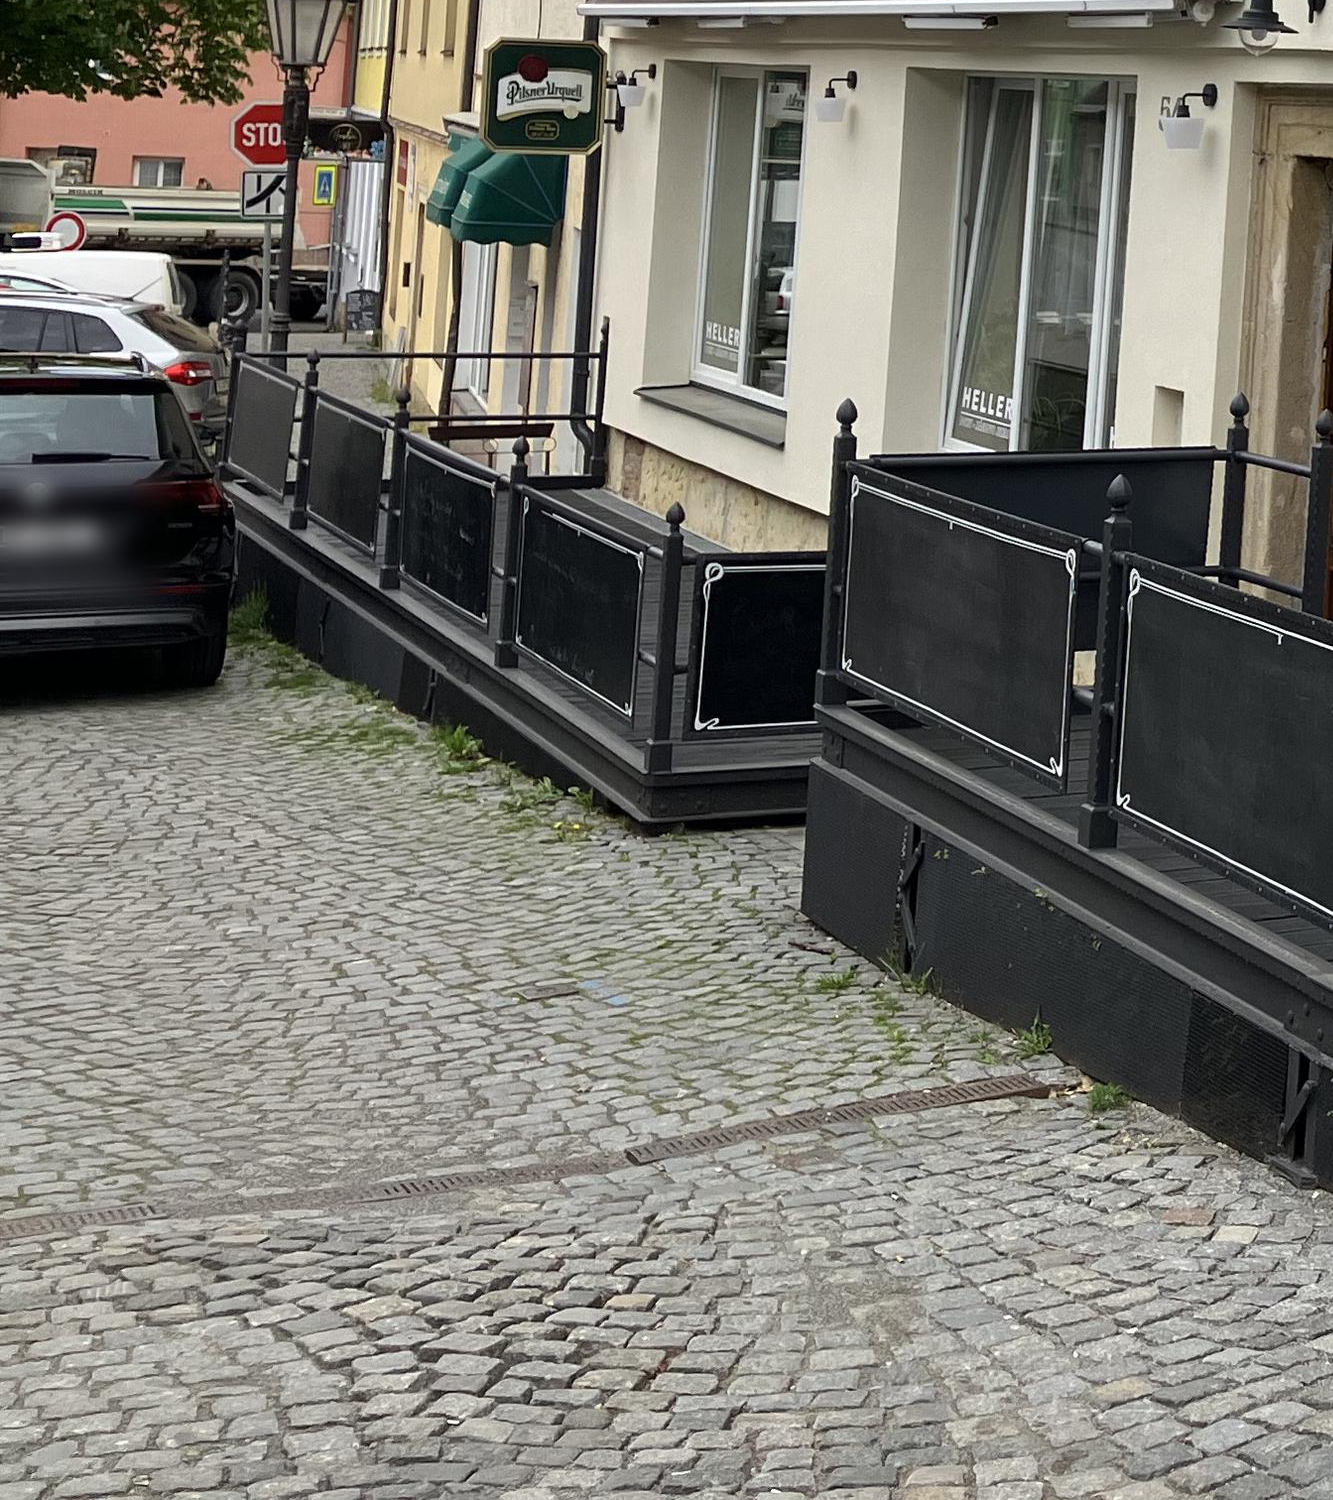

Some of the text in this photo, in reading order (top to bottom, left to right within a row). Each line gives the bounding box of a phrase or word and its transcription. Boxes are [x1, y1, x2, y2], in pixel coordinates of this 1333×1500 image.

[506, 80, 584, 106] Pilsner Urquell
[242, 122, 286, 147] STO
[705, 320, 740, 347] HELLER
[962, 386, 1014, 420] HELLER
